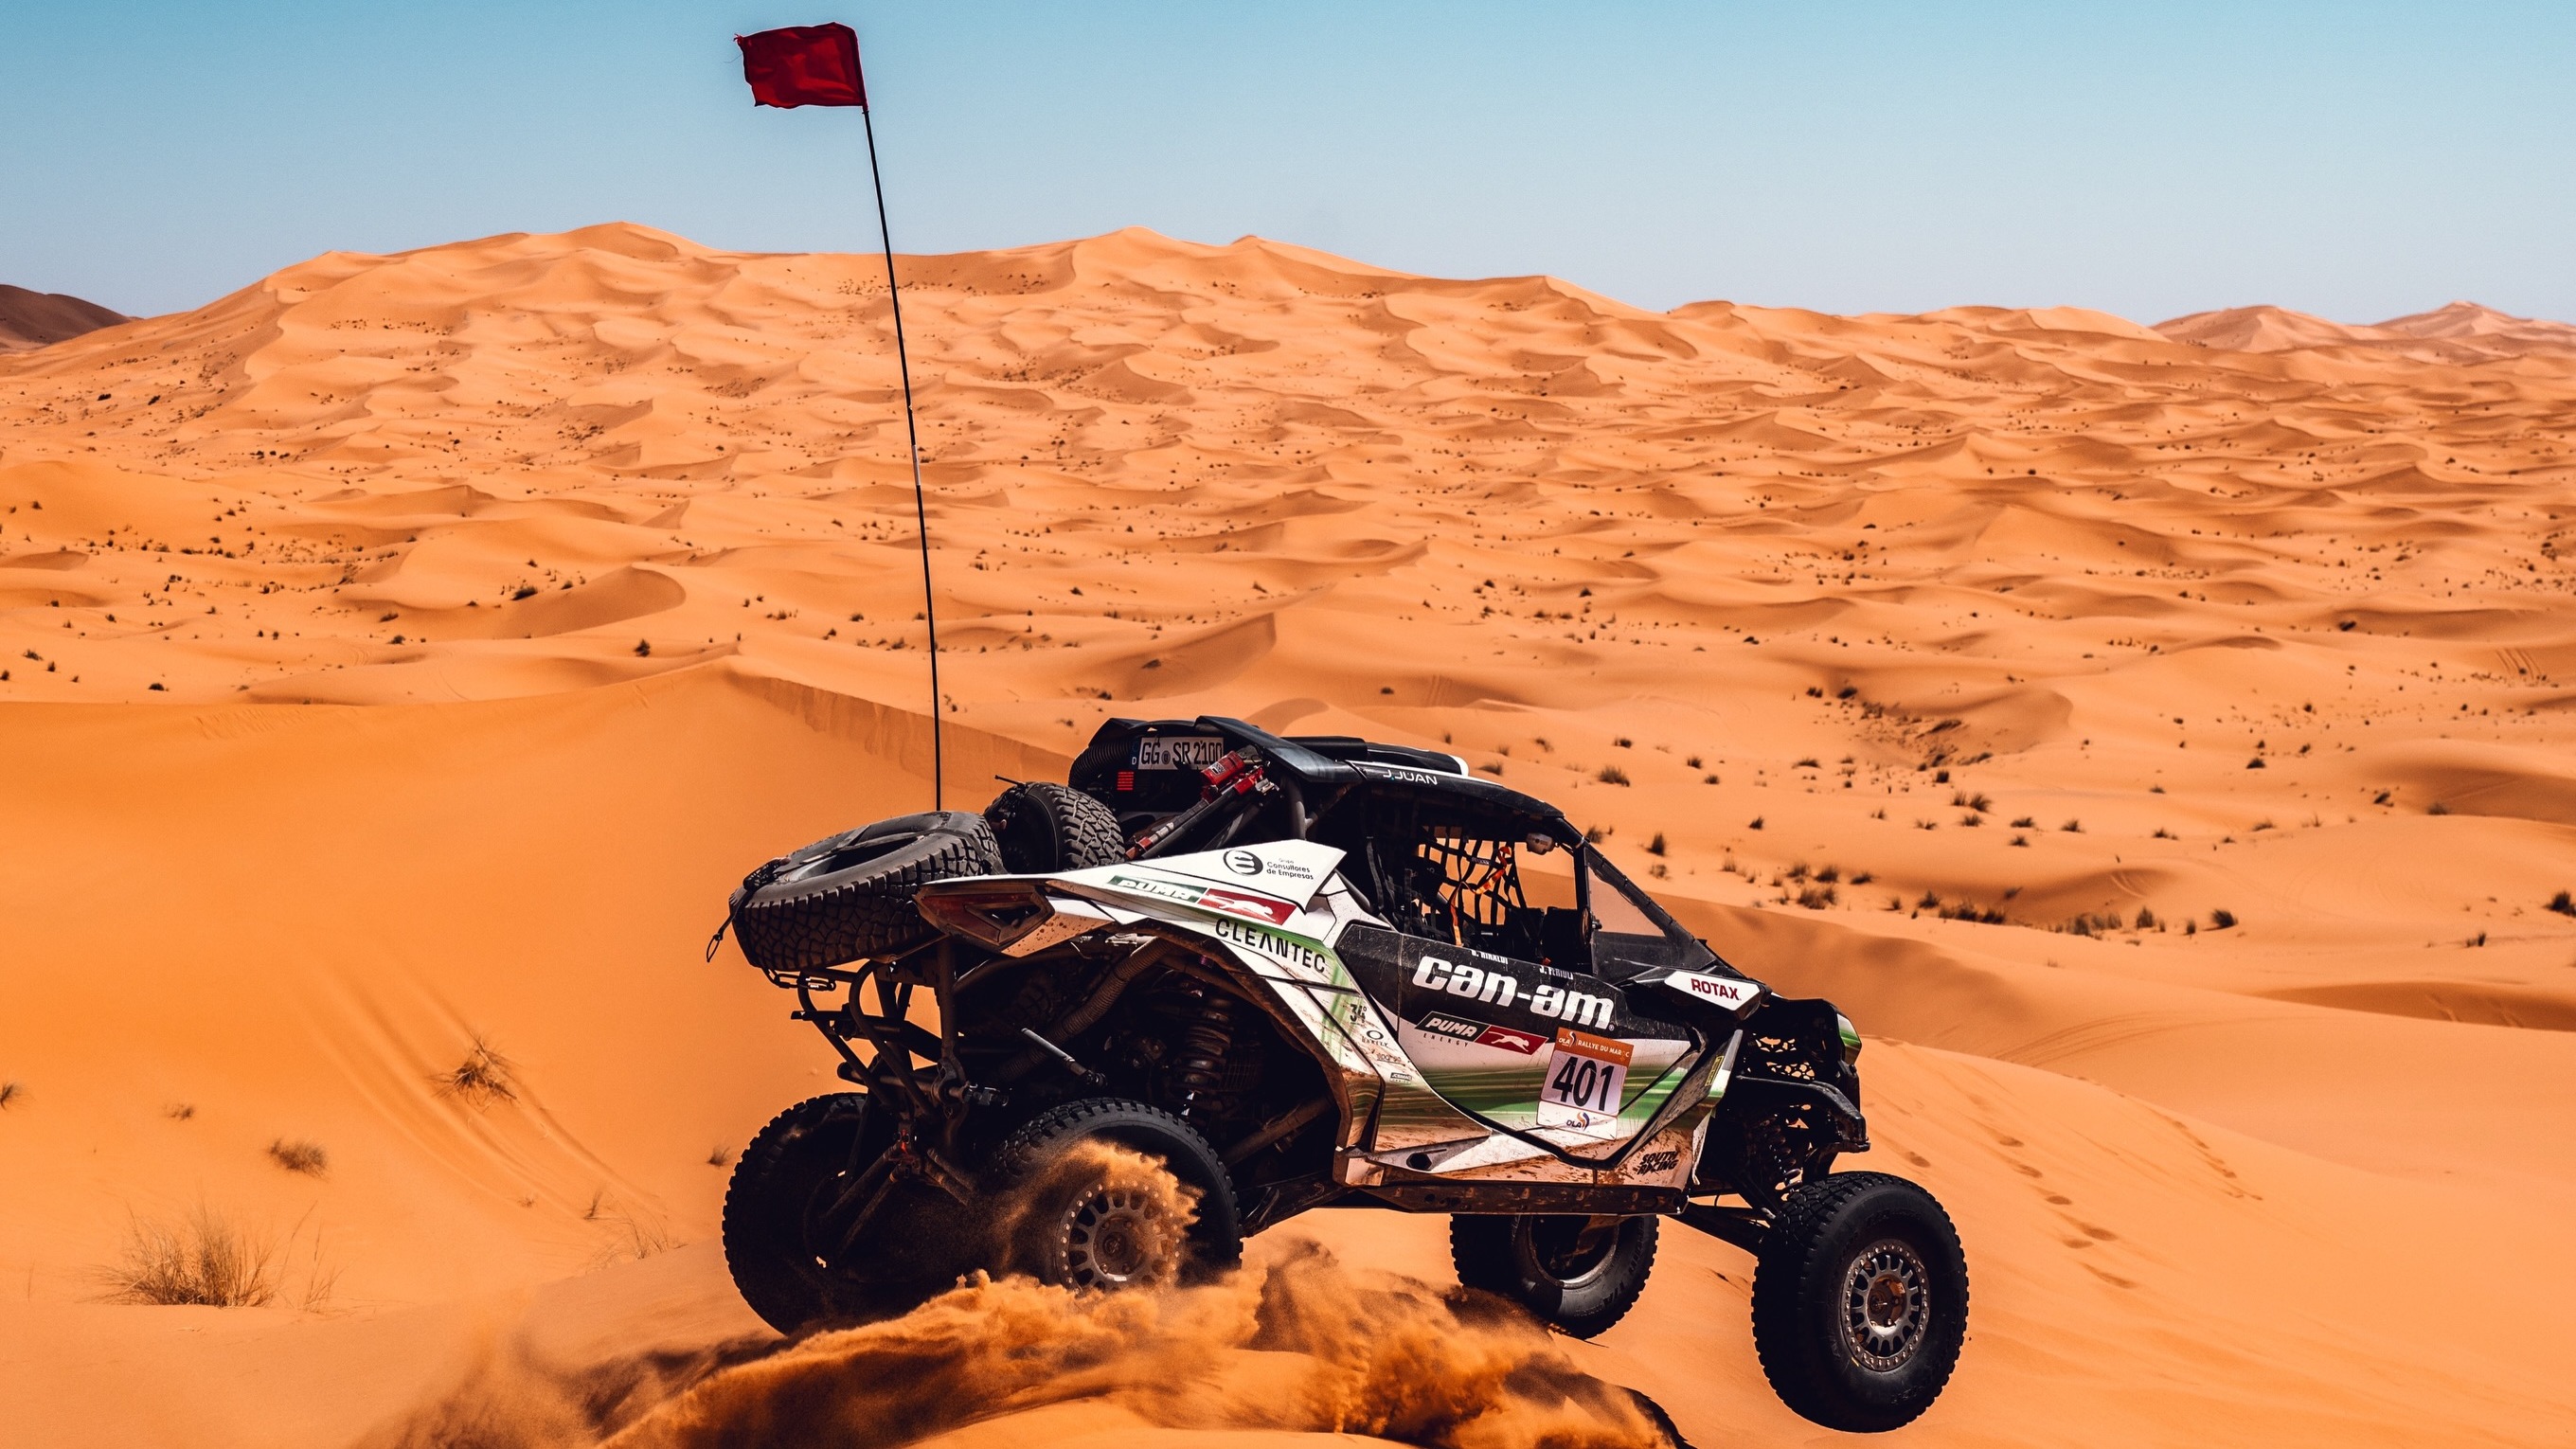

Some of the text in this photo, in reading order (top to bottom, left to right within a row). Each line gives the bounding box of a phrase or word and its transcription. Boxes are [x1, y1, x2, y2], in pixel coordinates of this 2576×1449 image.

[1140, 742, 1222, 765] GG SR 2100
[1383, 769, 1439, 785] J.JUAN
[1266, 861, 1311, 873] Consultores
[1278, 869, 1315, 880] Empresas
[1118, 878, 1199, 901] PUMA
[1215, 918, 1326, 974] CLEANTEC
[1412, 956, 1615, 1029] can-am
[1690, 978, 1740, 1001] ROTAX
[1425, 1017, 1477, 1037] PUMA
[1422, 1032, 1469, 1047] ENERGY
[1577, 1040, 1600, 1051] RALLYE
[1609, 1047, 1630, 1058] MARC
[1551, 1056, 1615, 1112] 401
